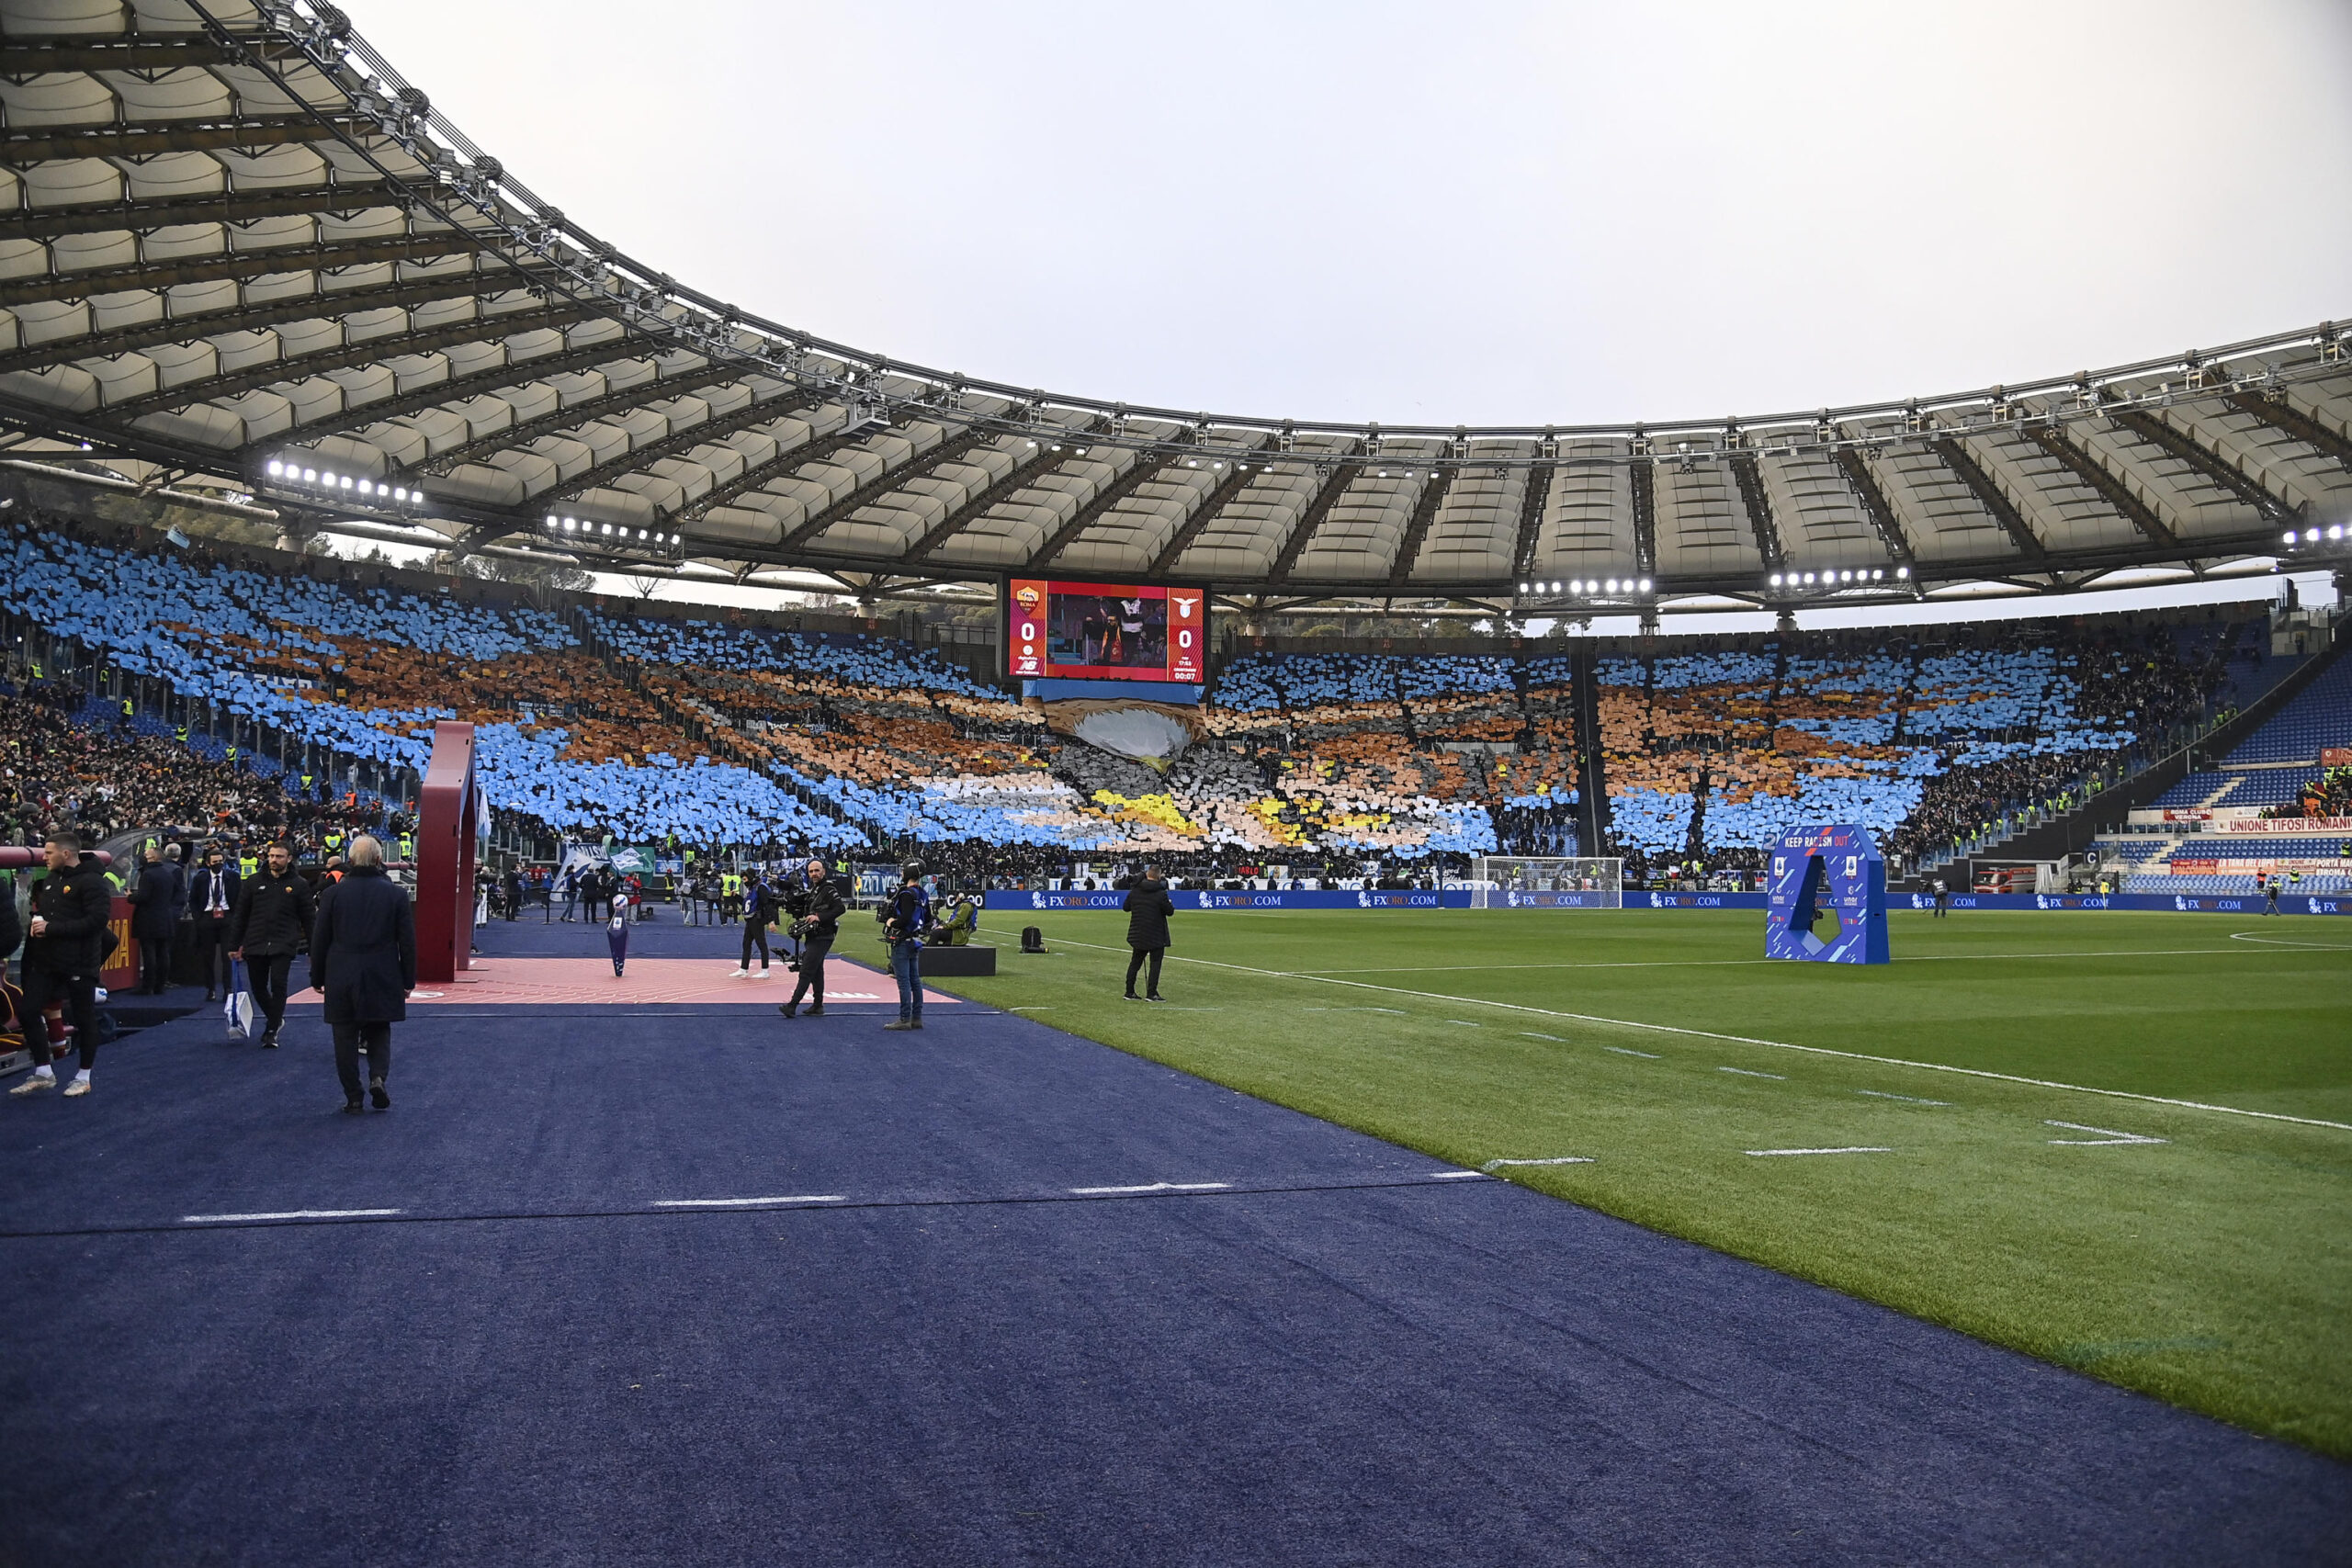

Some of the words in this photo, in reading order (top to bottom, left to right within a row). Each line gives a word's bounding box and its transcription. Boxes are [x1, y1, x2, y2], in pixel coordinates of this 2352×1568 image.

[1021, 623, 1035, 641] 0
[1179, 630, 1192, 649] 0
[2230, 819, 2268, 831] UNIONE
[2271, 818, 2304, 831] TIFOSI
[2308, 817, 2352, 829] ROMANI
[1785, 837, 1803, 848] KEEP
[1804, 836, 1832, 848] RACISM
[1835, 836, 1849, 846] OUT
[2087, 852, 2097, 863] C
[2316, 859, 2338, 868] PORTA
[745, 899, 751, 912] 6
[1049, 896, 1118, 907] FXORO.COM
[1216, 896, 1281, 906] FXORO.COM
[1374, 895, 1436, 906] FXORO.COM
[1665, 896, 1721, 907] FXORO.COM
